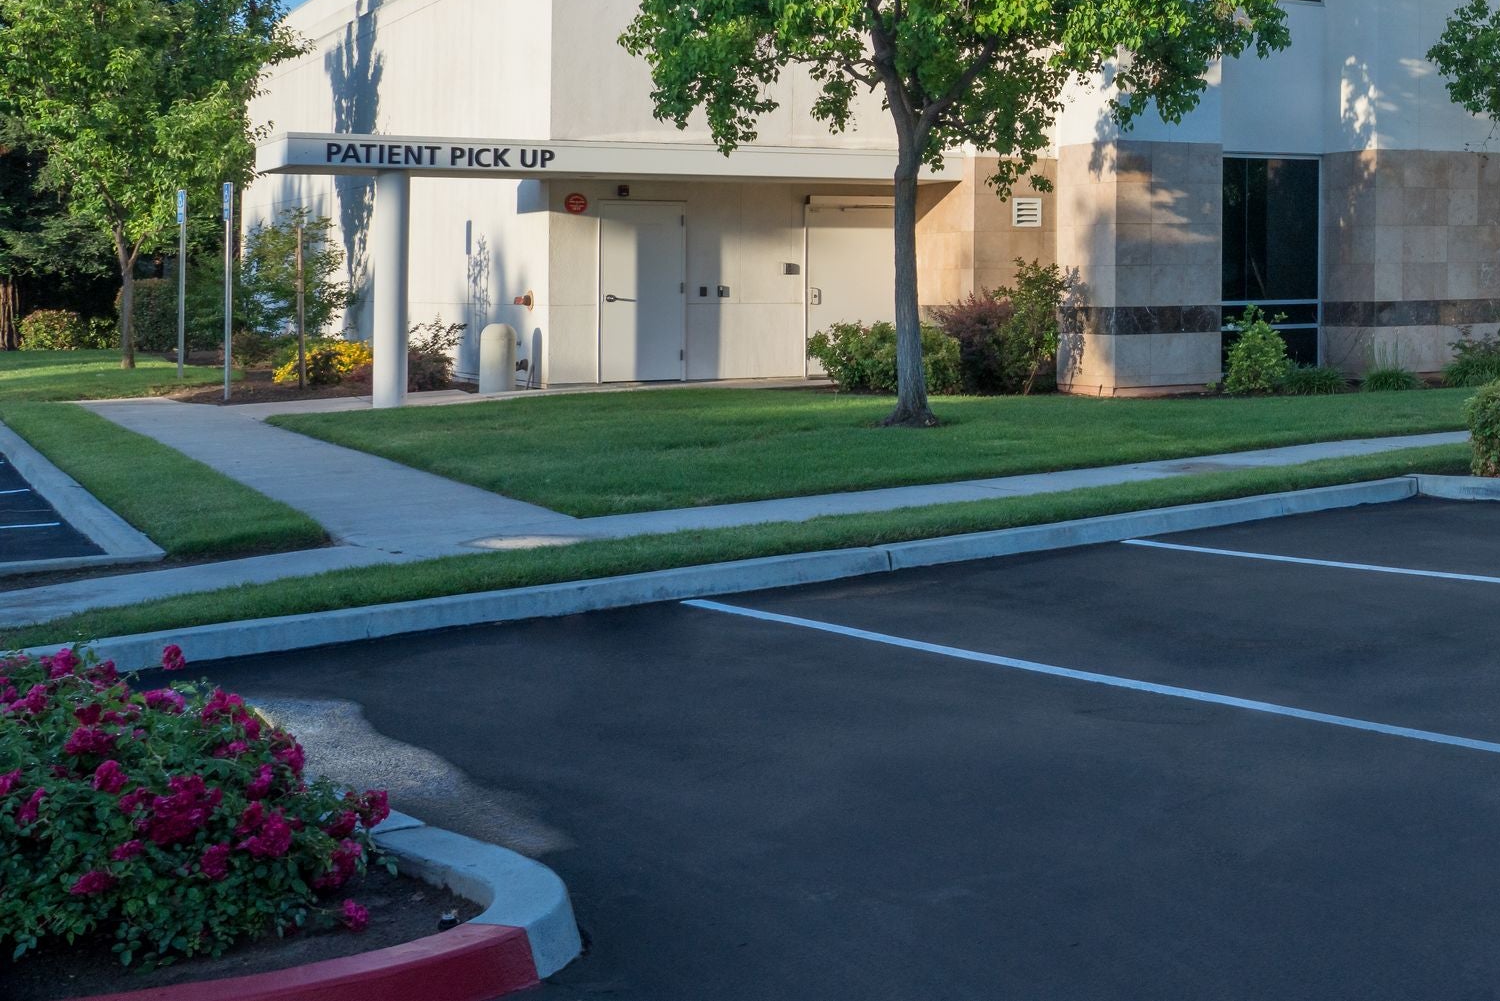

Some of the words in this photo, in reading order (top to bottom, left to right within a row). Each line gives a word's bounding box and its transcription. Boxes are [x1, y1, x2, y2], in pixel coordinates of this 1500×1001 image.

[326, 142, 441, 166] PATIENT
[450, 146, 511, 168] PICK
[520, 149, 556, 169] UP
